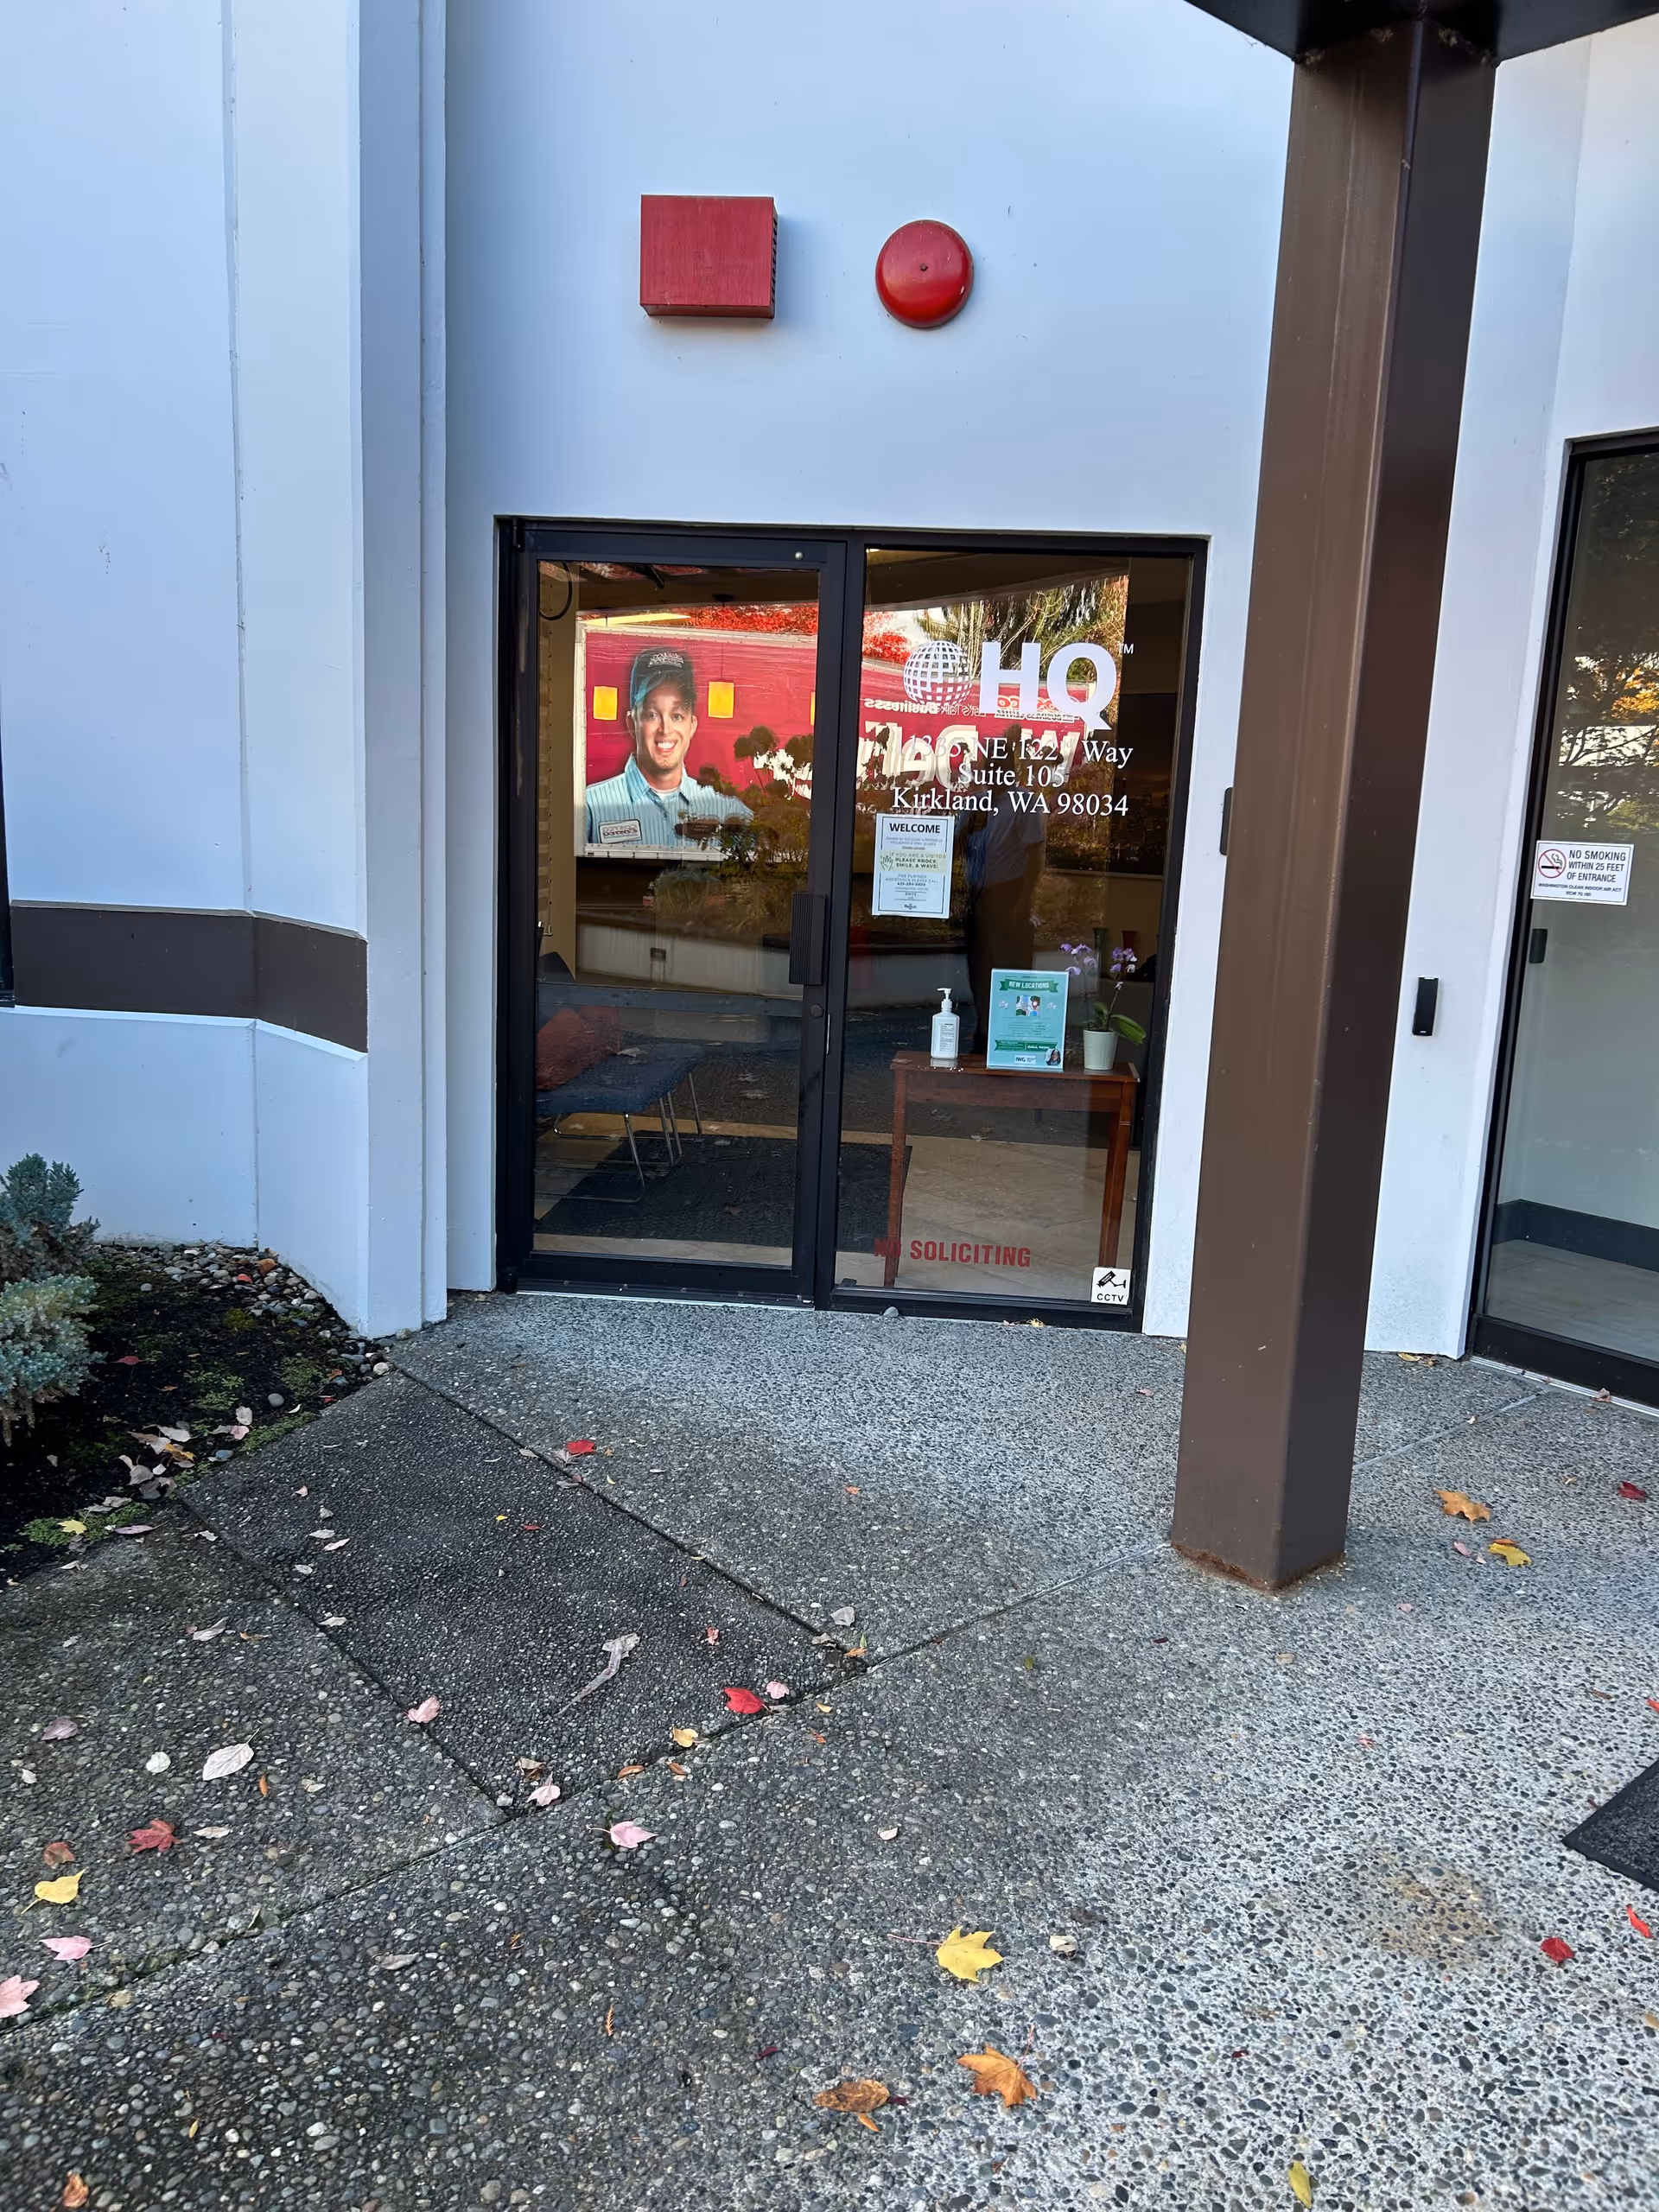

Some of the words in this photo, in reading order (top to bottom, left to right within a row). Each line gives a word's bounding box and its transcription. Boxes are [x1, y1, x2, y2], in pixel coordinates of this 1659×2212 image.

[979, 641, 1117, 730] HQ
[971, 737, 1008, 760] NE
[1082, 740, 1134, 769] Way
[958, 763, 1016, 785] Suite
[1026, 765, 1065, 788] 105
[893, 787, 999, 817] Kirkland,
[1007, 791, 1051, 814] WA
[1058, 792, 1128, 817] 98034
[889, 823, 940, 834] WELCOME
[1568, 849, 1581, 859] NO
[1585, 850, 1626, 861] SMOKING
[1568, 861, 1594, 870] WITHIN
[1606, 863, 1625, 872] FEET
[1567, 871, 1577, 880] OF
[1578, 872, 1617, 882] ENTRANCE
[874, 1238, 902, 1259] NO
[910, 1240, 1031, 1268] SOLICITING
[1096, 1293, 1124, 1302] CCTV
